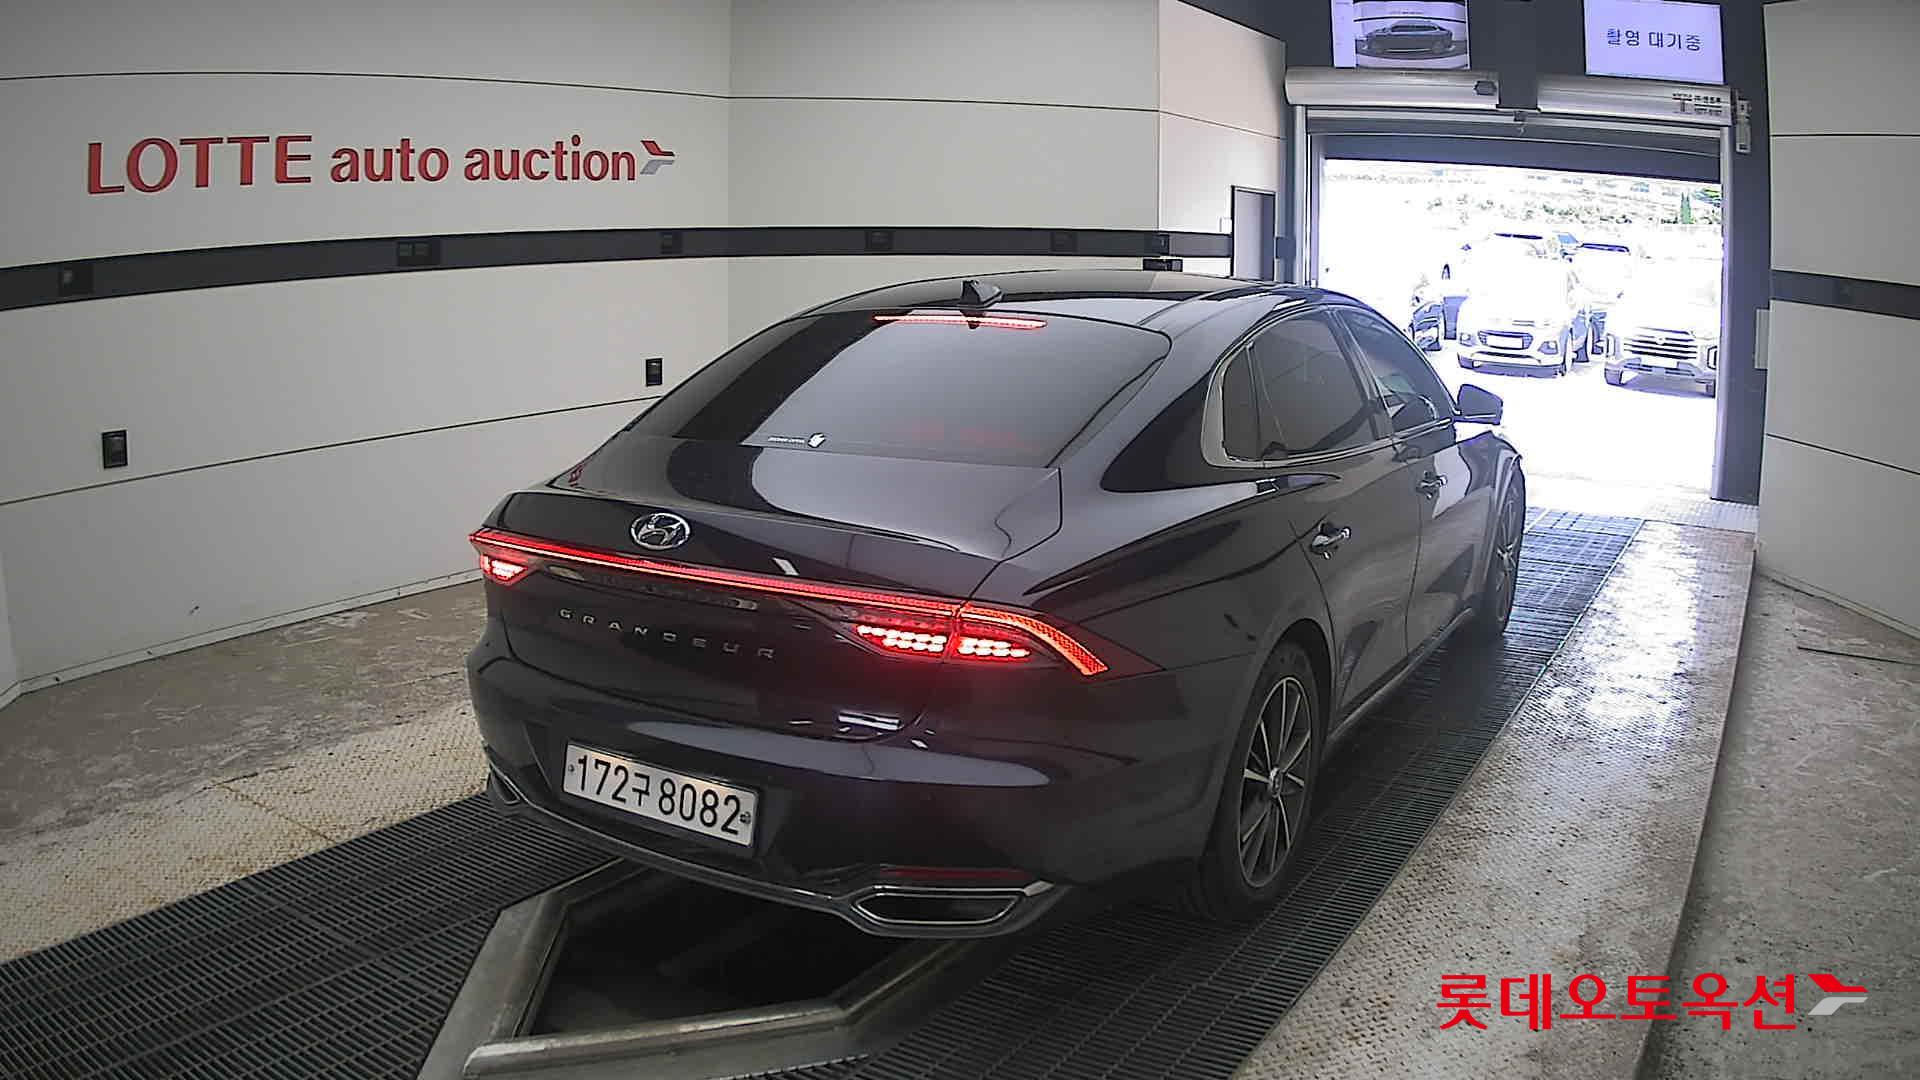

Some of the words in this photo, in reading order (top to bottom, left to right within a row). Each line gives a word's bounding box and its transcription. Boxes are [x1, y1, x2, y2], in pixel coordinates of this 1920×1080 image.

[1607, 28, 1640, 47] 촬영
[88, 135, 312, 194] LOTTE
[330, 138, 449, 182] auto
[463, 134, 636, 181] auction
[559, 608, 774, 659] GRANDEUR
